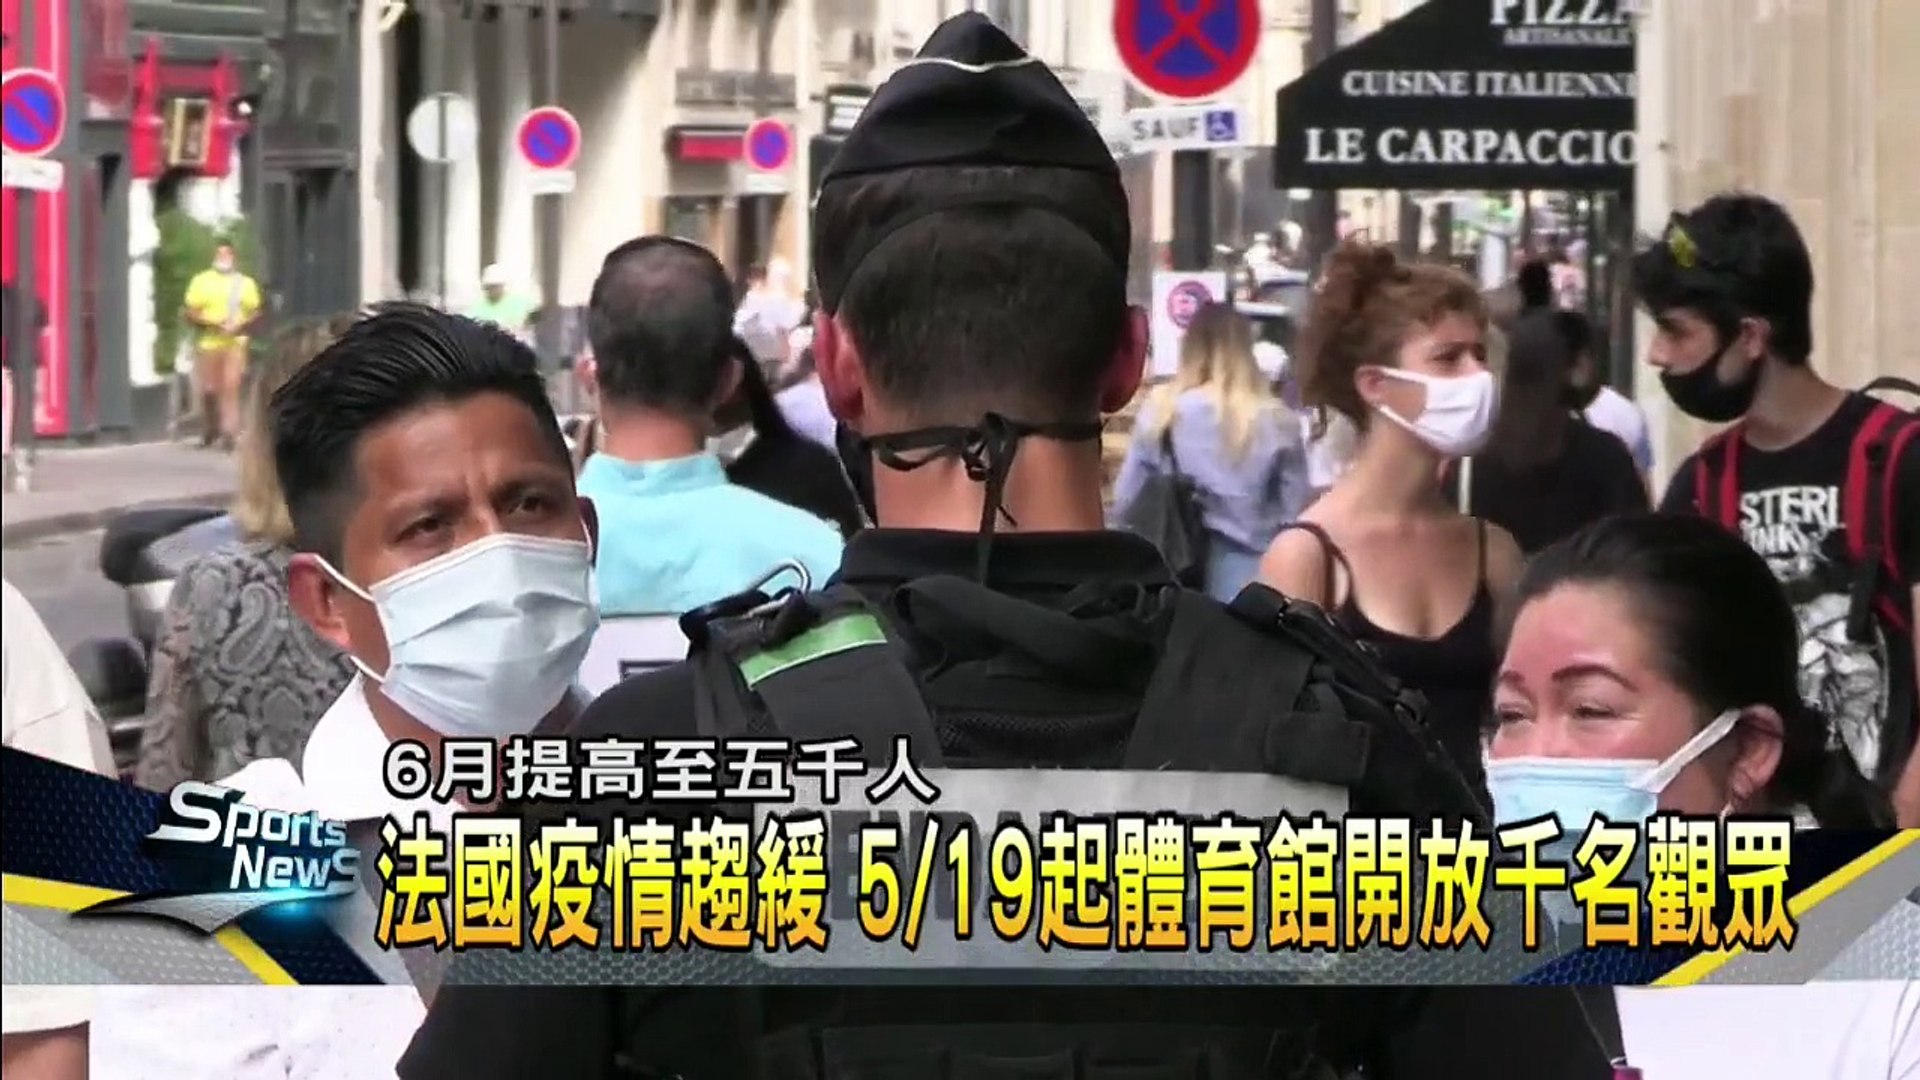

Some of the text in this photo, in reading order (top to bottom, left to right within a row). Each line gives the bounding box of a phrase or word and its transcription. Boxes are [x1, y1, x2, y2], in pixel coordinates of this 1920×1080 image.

[1342, 70, 1469, 97] CUISINE
[1305, 127, 1637, 165] LE CARPACCIO
